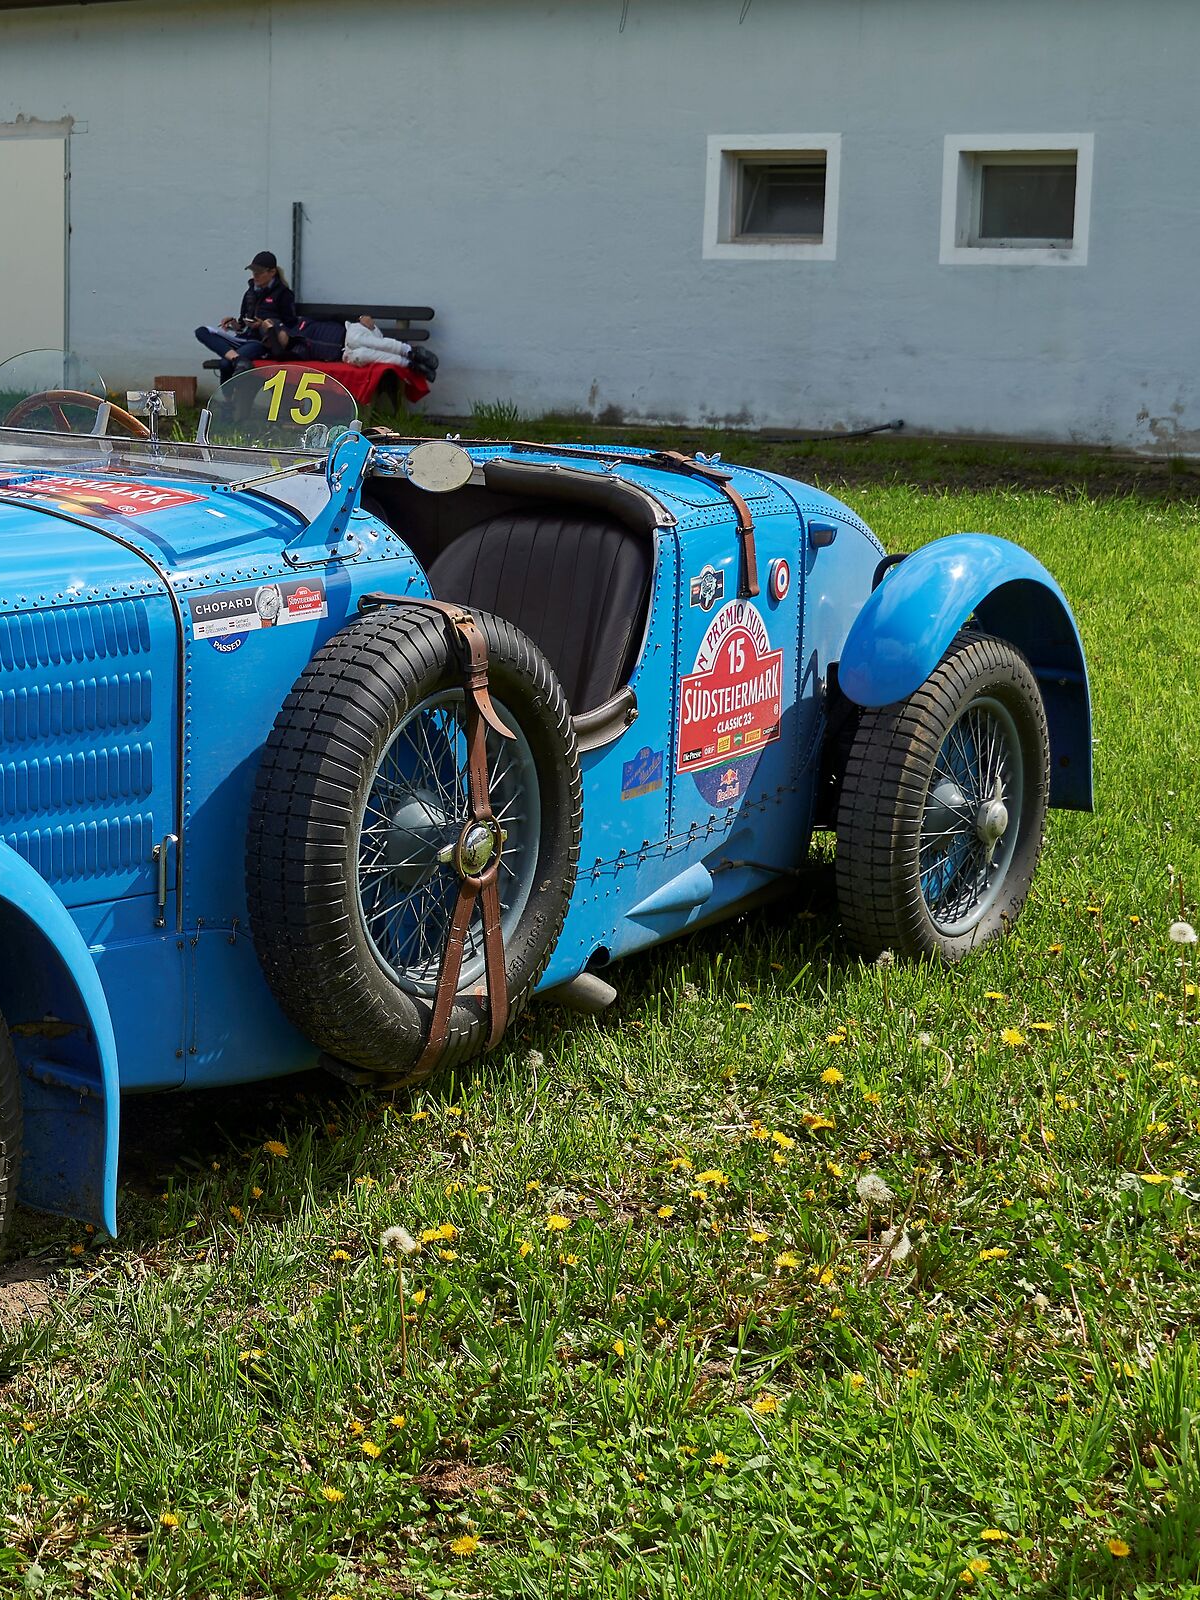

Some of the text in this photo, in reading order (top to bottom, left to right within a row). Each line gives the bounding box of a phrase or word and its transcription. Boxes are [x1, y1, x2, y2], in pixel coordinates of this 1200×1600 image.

[263, 370, 325, 424] 15
[195, 597, 253, 615] CHOPARD
[706, 603, 744, 653] PREMIO
[213, 639, 241, 652] PASSED
[728, 637, 746, 675] 15
[683, 661, 780, 725] SÜDSTEIERMARK
